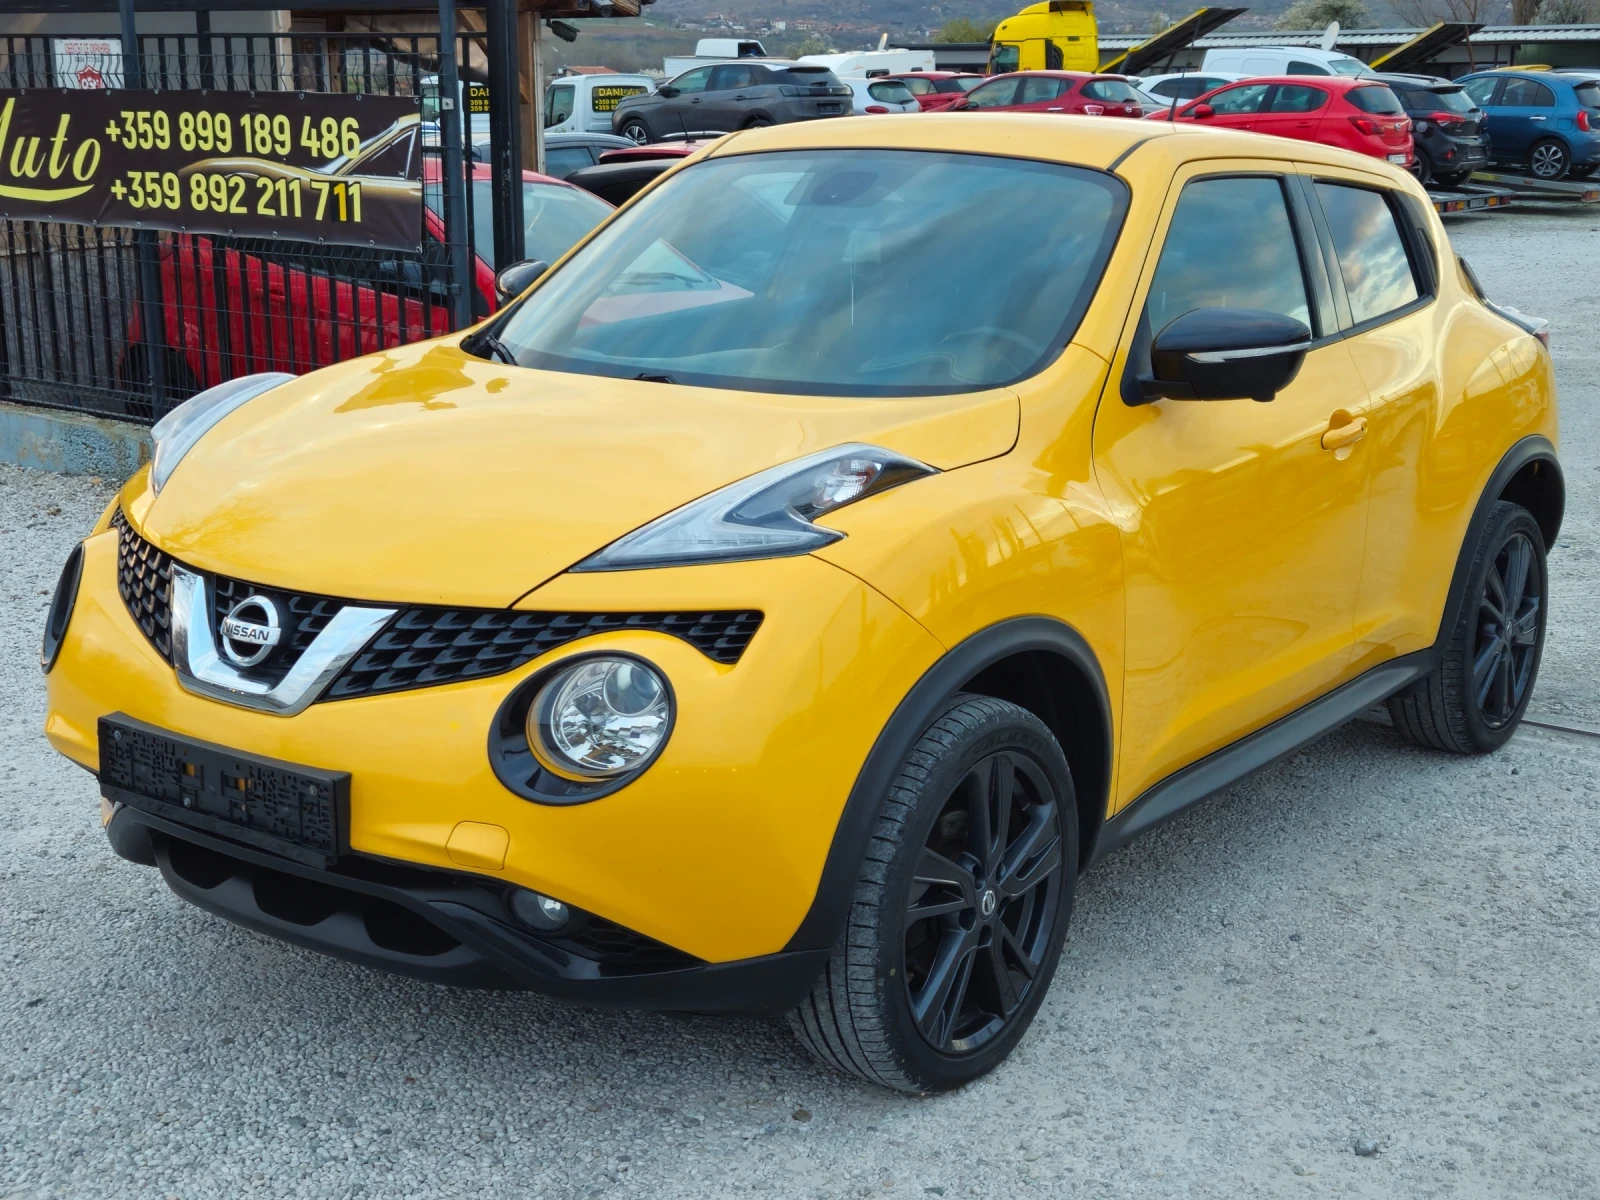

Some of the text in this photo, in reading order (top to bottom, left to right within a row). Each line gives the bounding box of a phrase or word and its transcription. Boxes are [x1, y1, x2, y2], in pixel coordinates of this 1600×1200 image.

[598, 88, 623, 97] DANI
[105, 110, 361, 159] +359 899 189 486
[110, 171, 362, 223] +359 892 211 711
[224, 620, 270, 641] NISSAN
